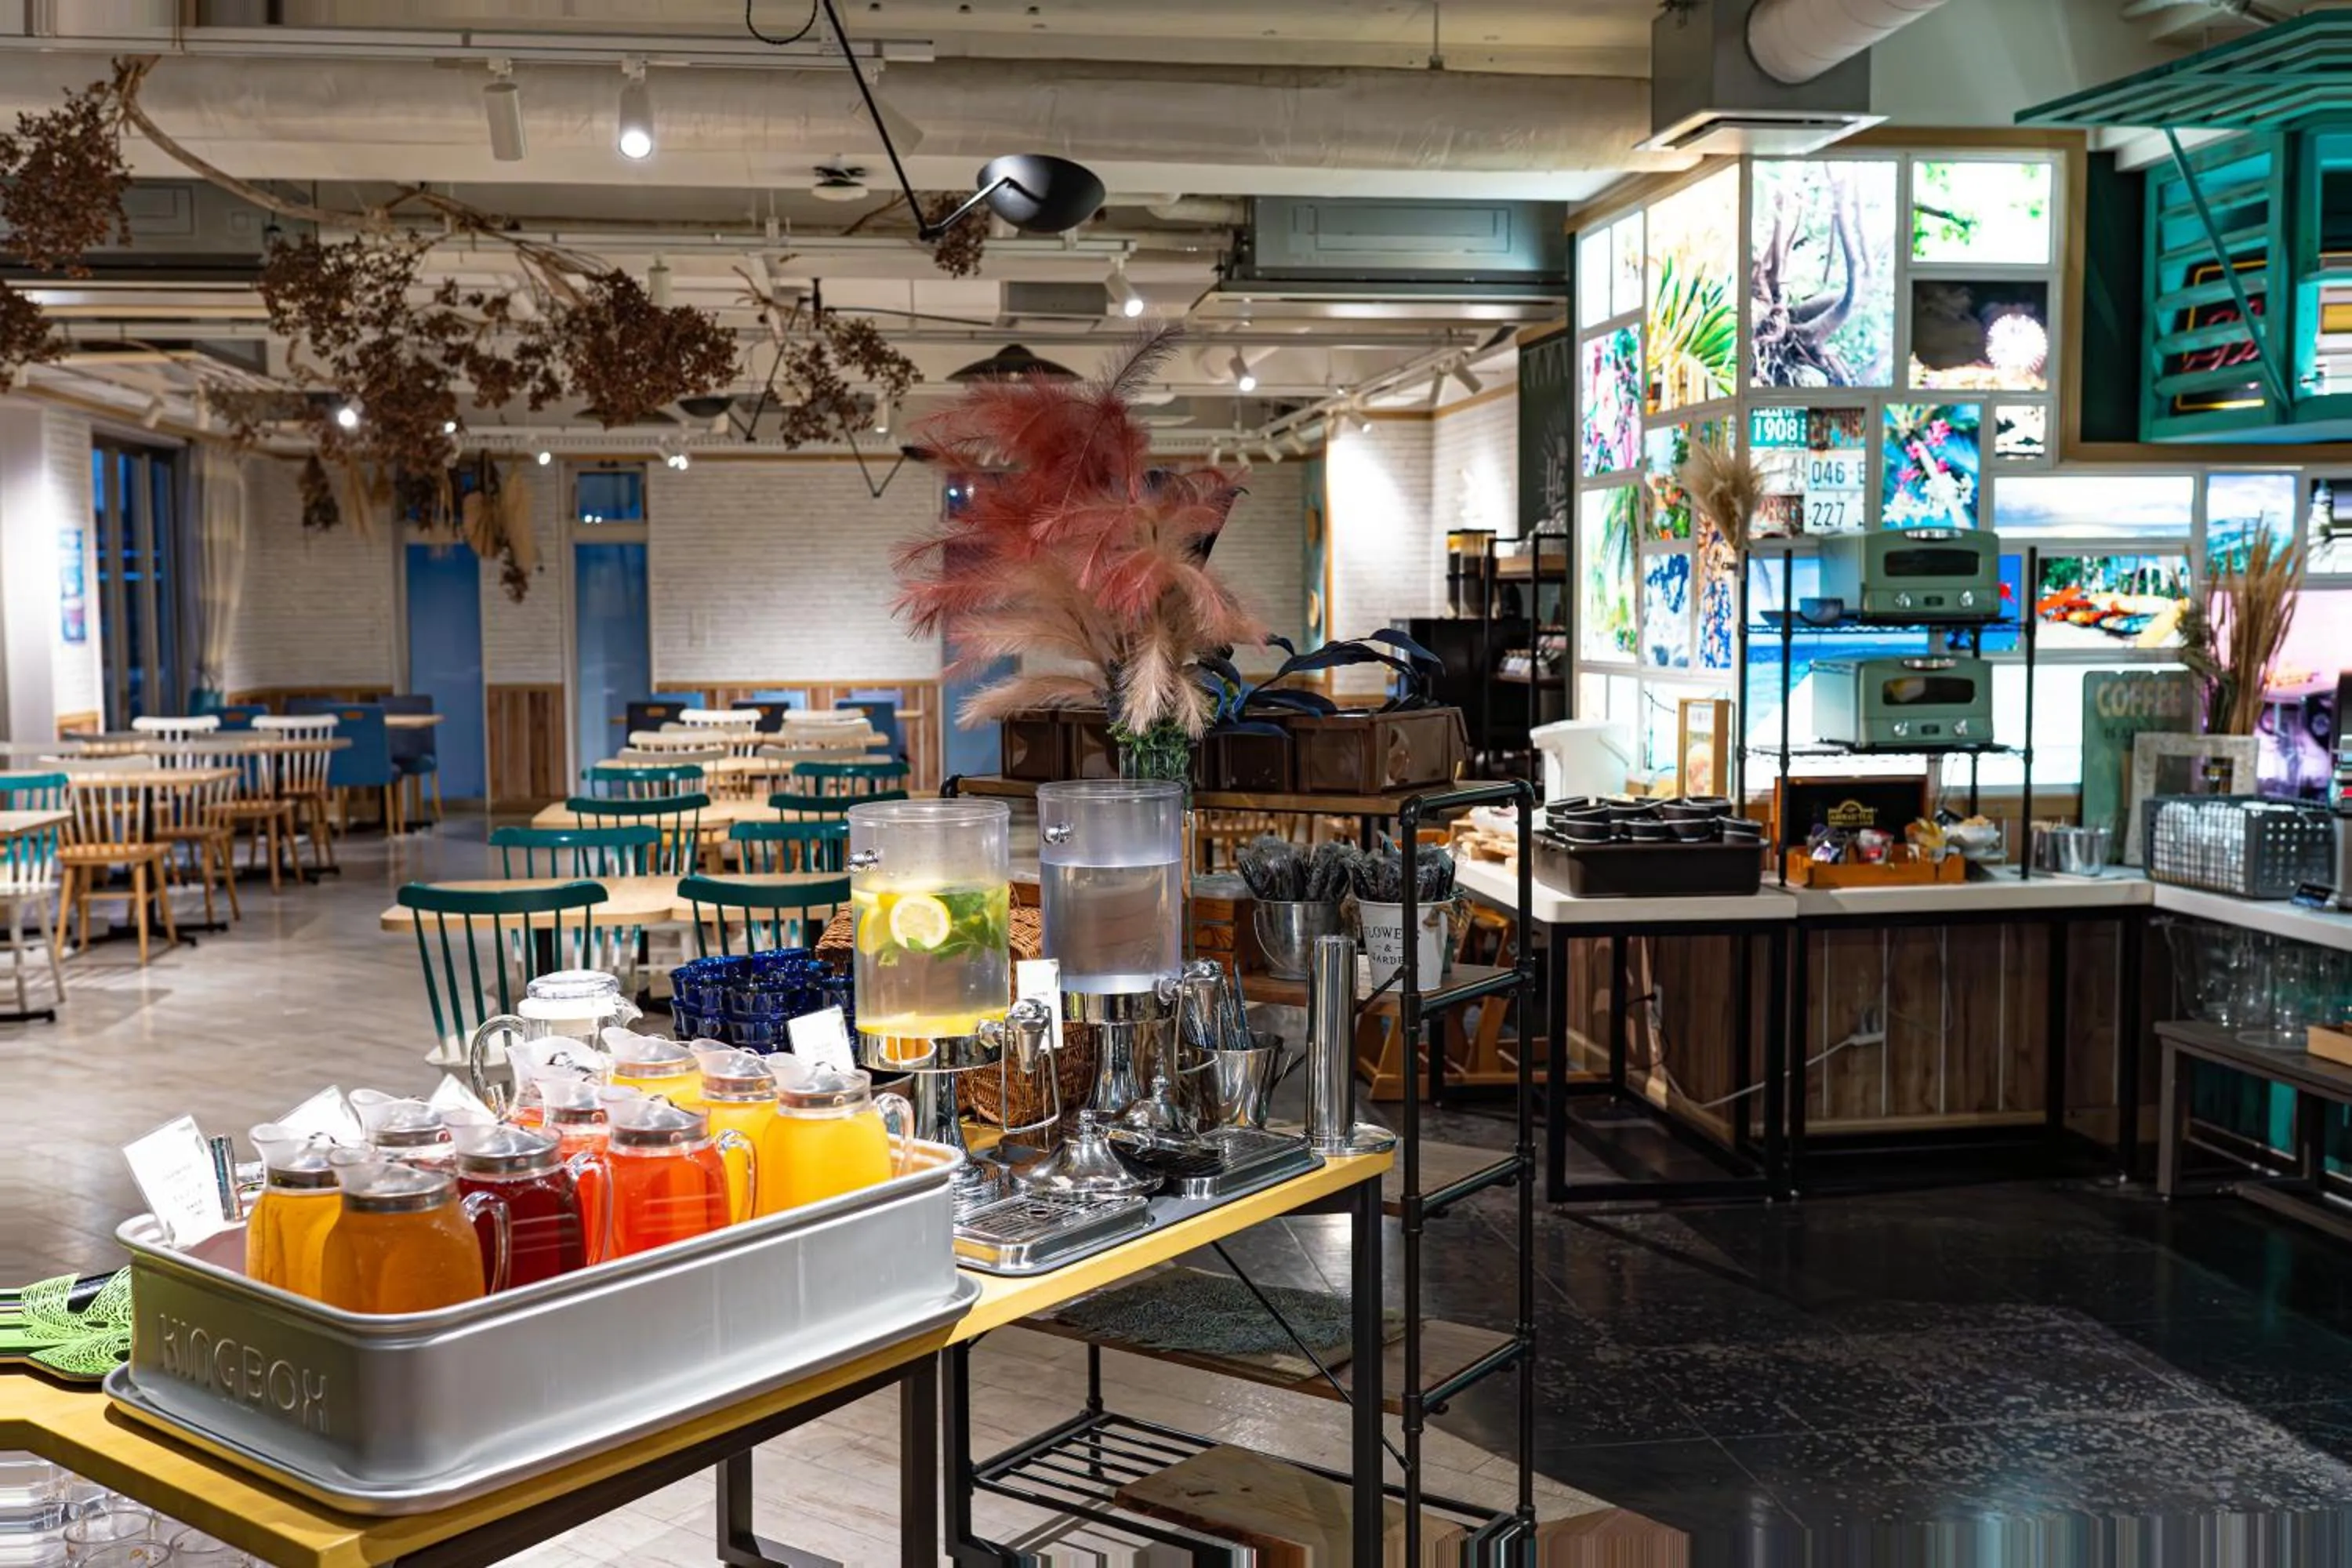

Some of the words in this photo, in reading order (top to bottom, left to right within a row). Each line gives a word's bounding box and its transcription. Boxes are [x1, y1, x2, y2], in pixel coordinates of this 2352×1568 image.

[1754, 417, 1798, 441] 1908
[1812, 461, 1846, 484] 046
[1812, 502, 1845, 526] 227
[2096, 681, 2183, 718] COFFEE
[1384, 943, 1392, 953] &
[159, 1312, 330, 1435] KINGBOX
